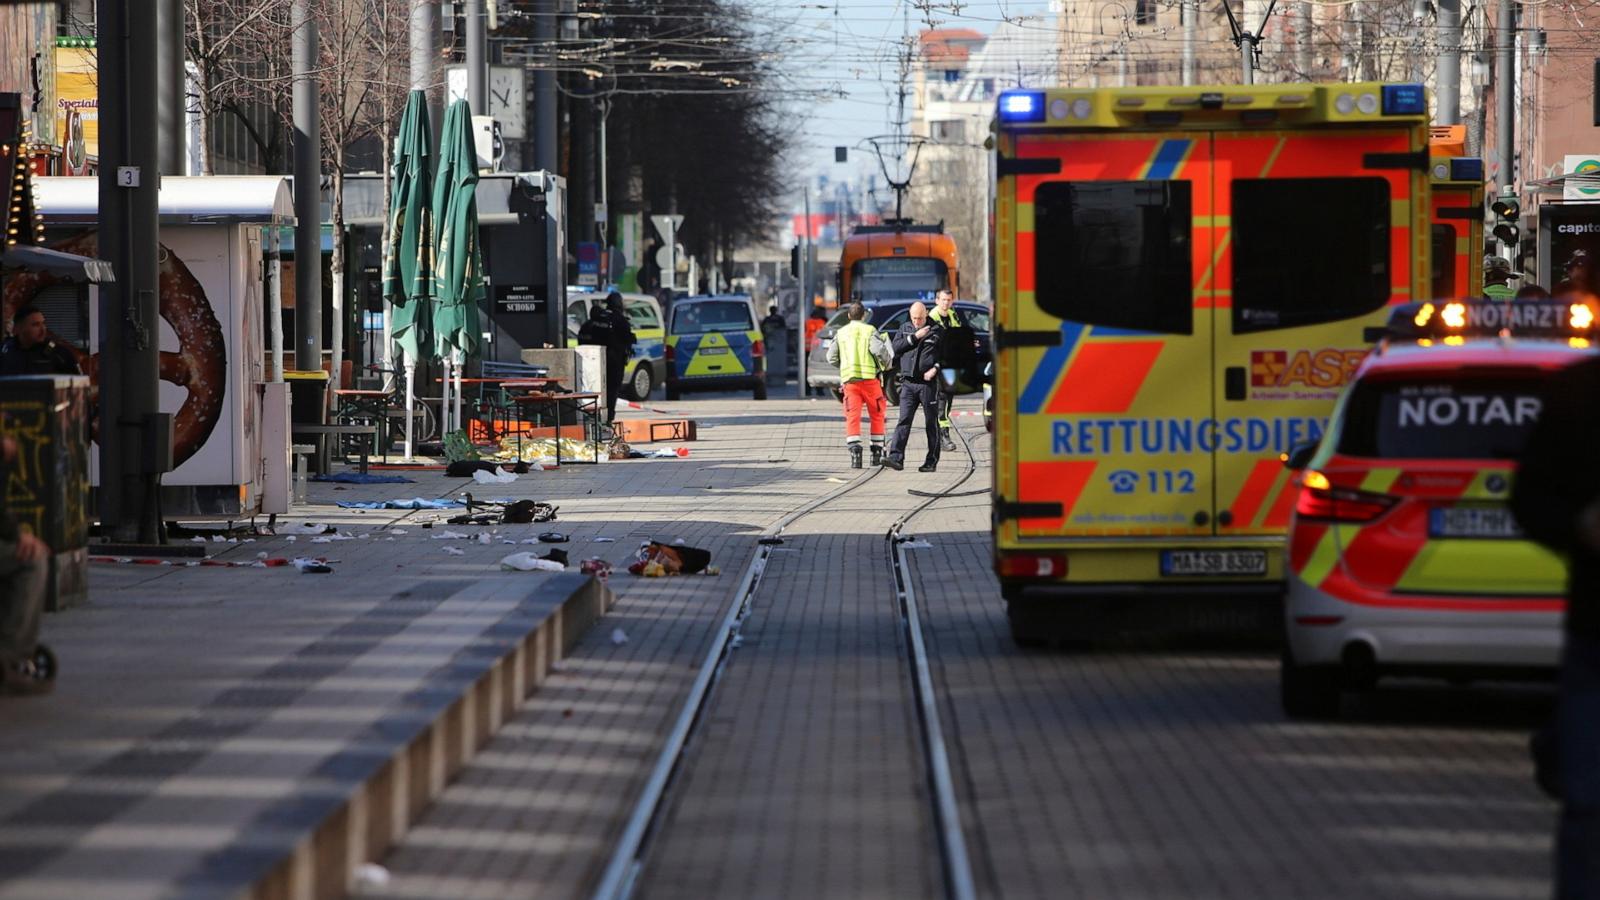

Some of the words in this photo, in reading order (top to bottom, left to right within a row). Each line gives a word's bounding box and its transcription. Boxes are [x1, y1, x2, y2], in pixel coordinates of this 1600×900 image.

[125, 170, 132, 185] 3
[1469, 304, 1566, 328] NOTARZT
[1398, 396, 1543, 427] NOTAR
[1147, 469, 1196, 494] 112
